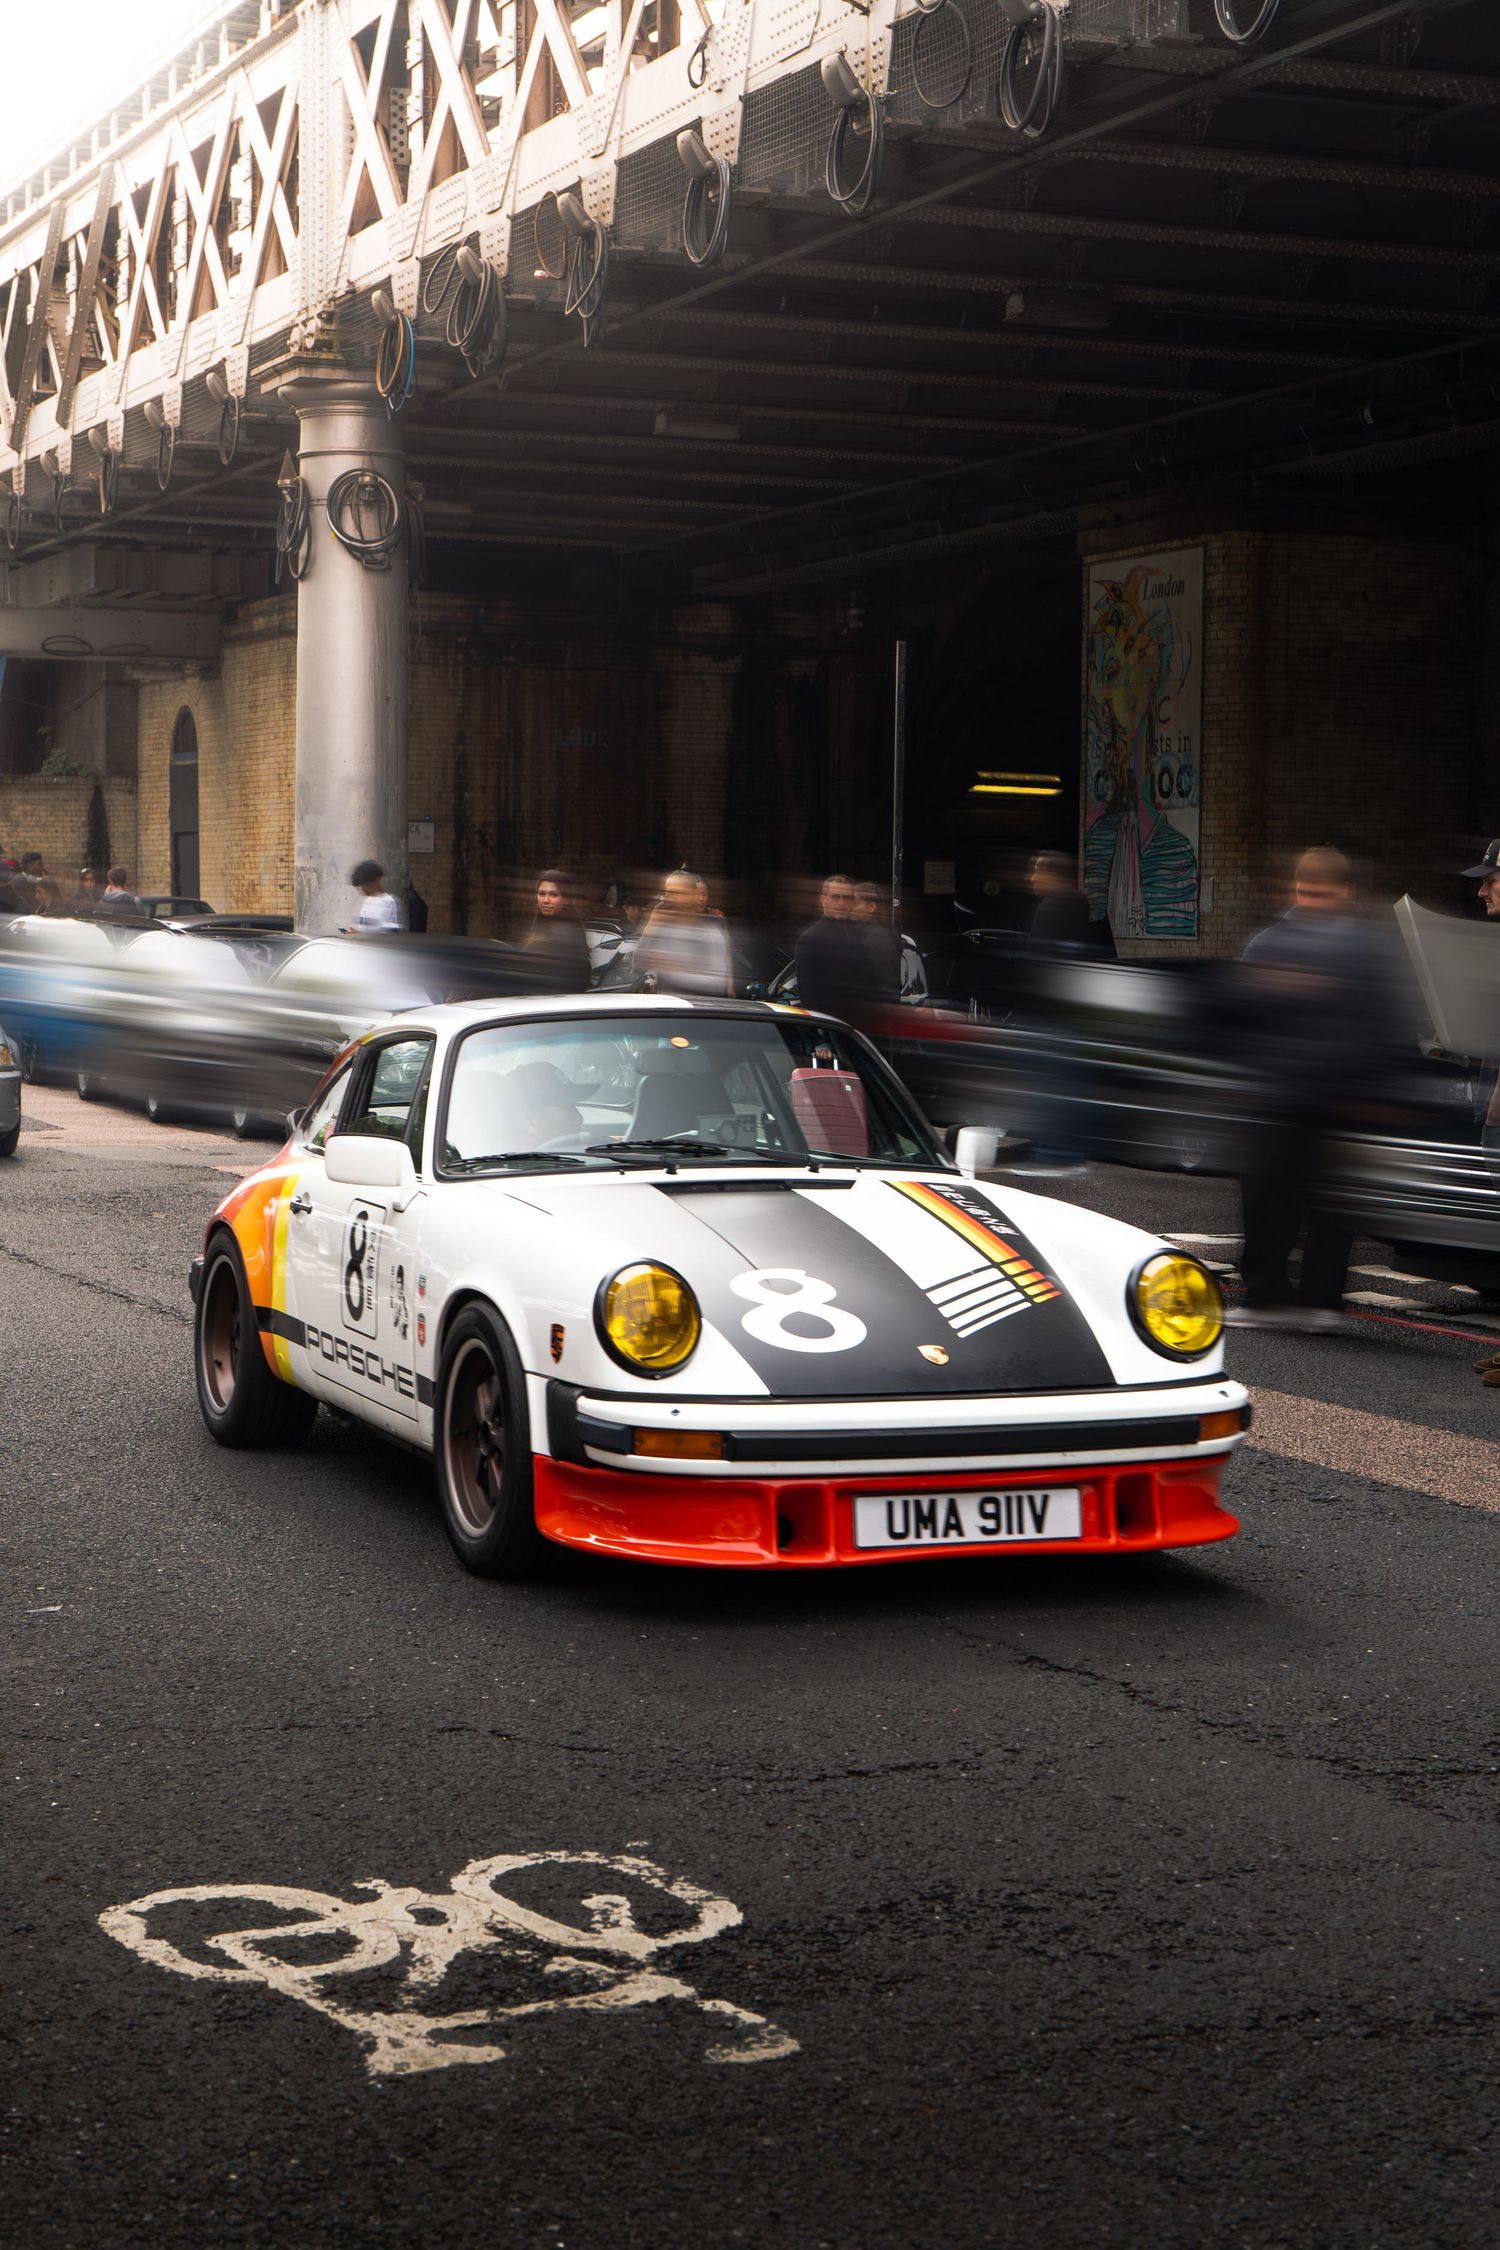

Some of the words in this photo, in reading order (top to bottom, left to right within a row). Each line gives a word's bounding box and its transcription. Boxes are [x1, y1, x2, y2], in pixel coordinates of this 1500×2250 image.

[1143, 574, 1185, 600] London
[345, 1210, 369, 1322] 8
[729, 1268, 867, 1354] 8
[306, 1324, 415, 1399] PORSCHE
[886, 1497, 966, 1540] UMA
[975, 1493, 1050, 1536] 911V
